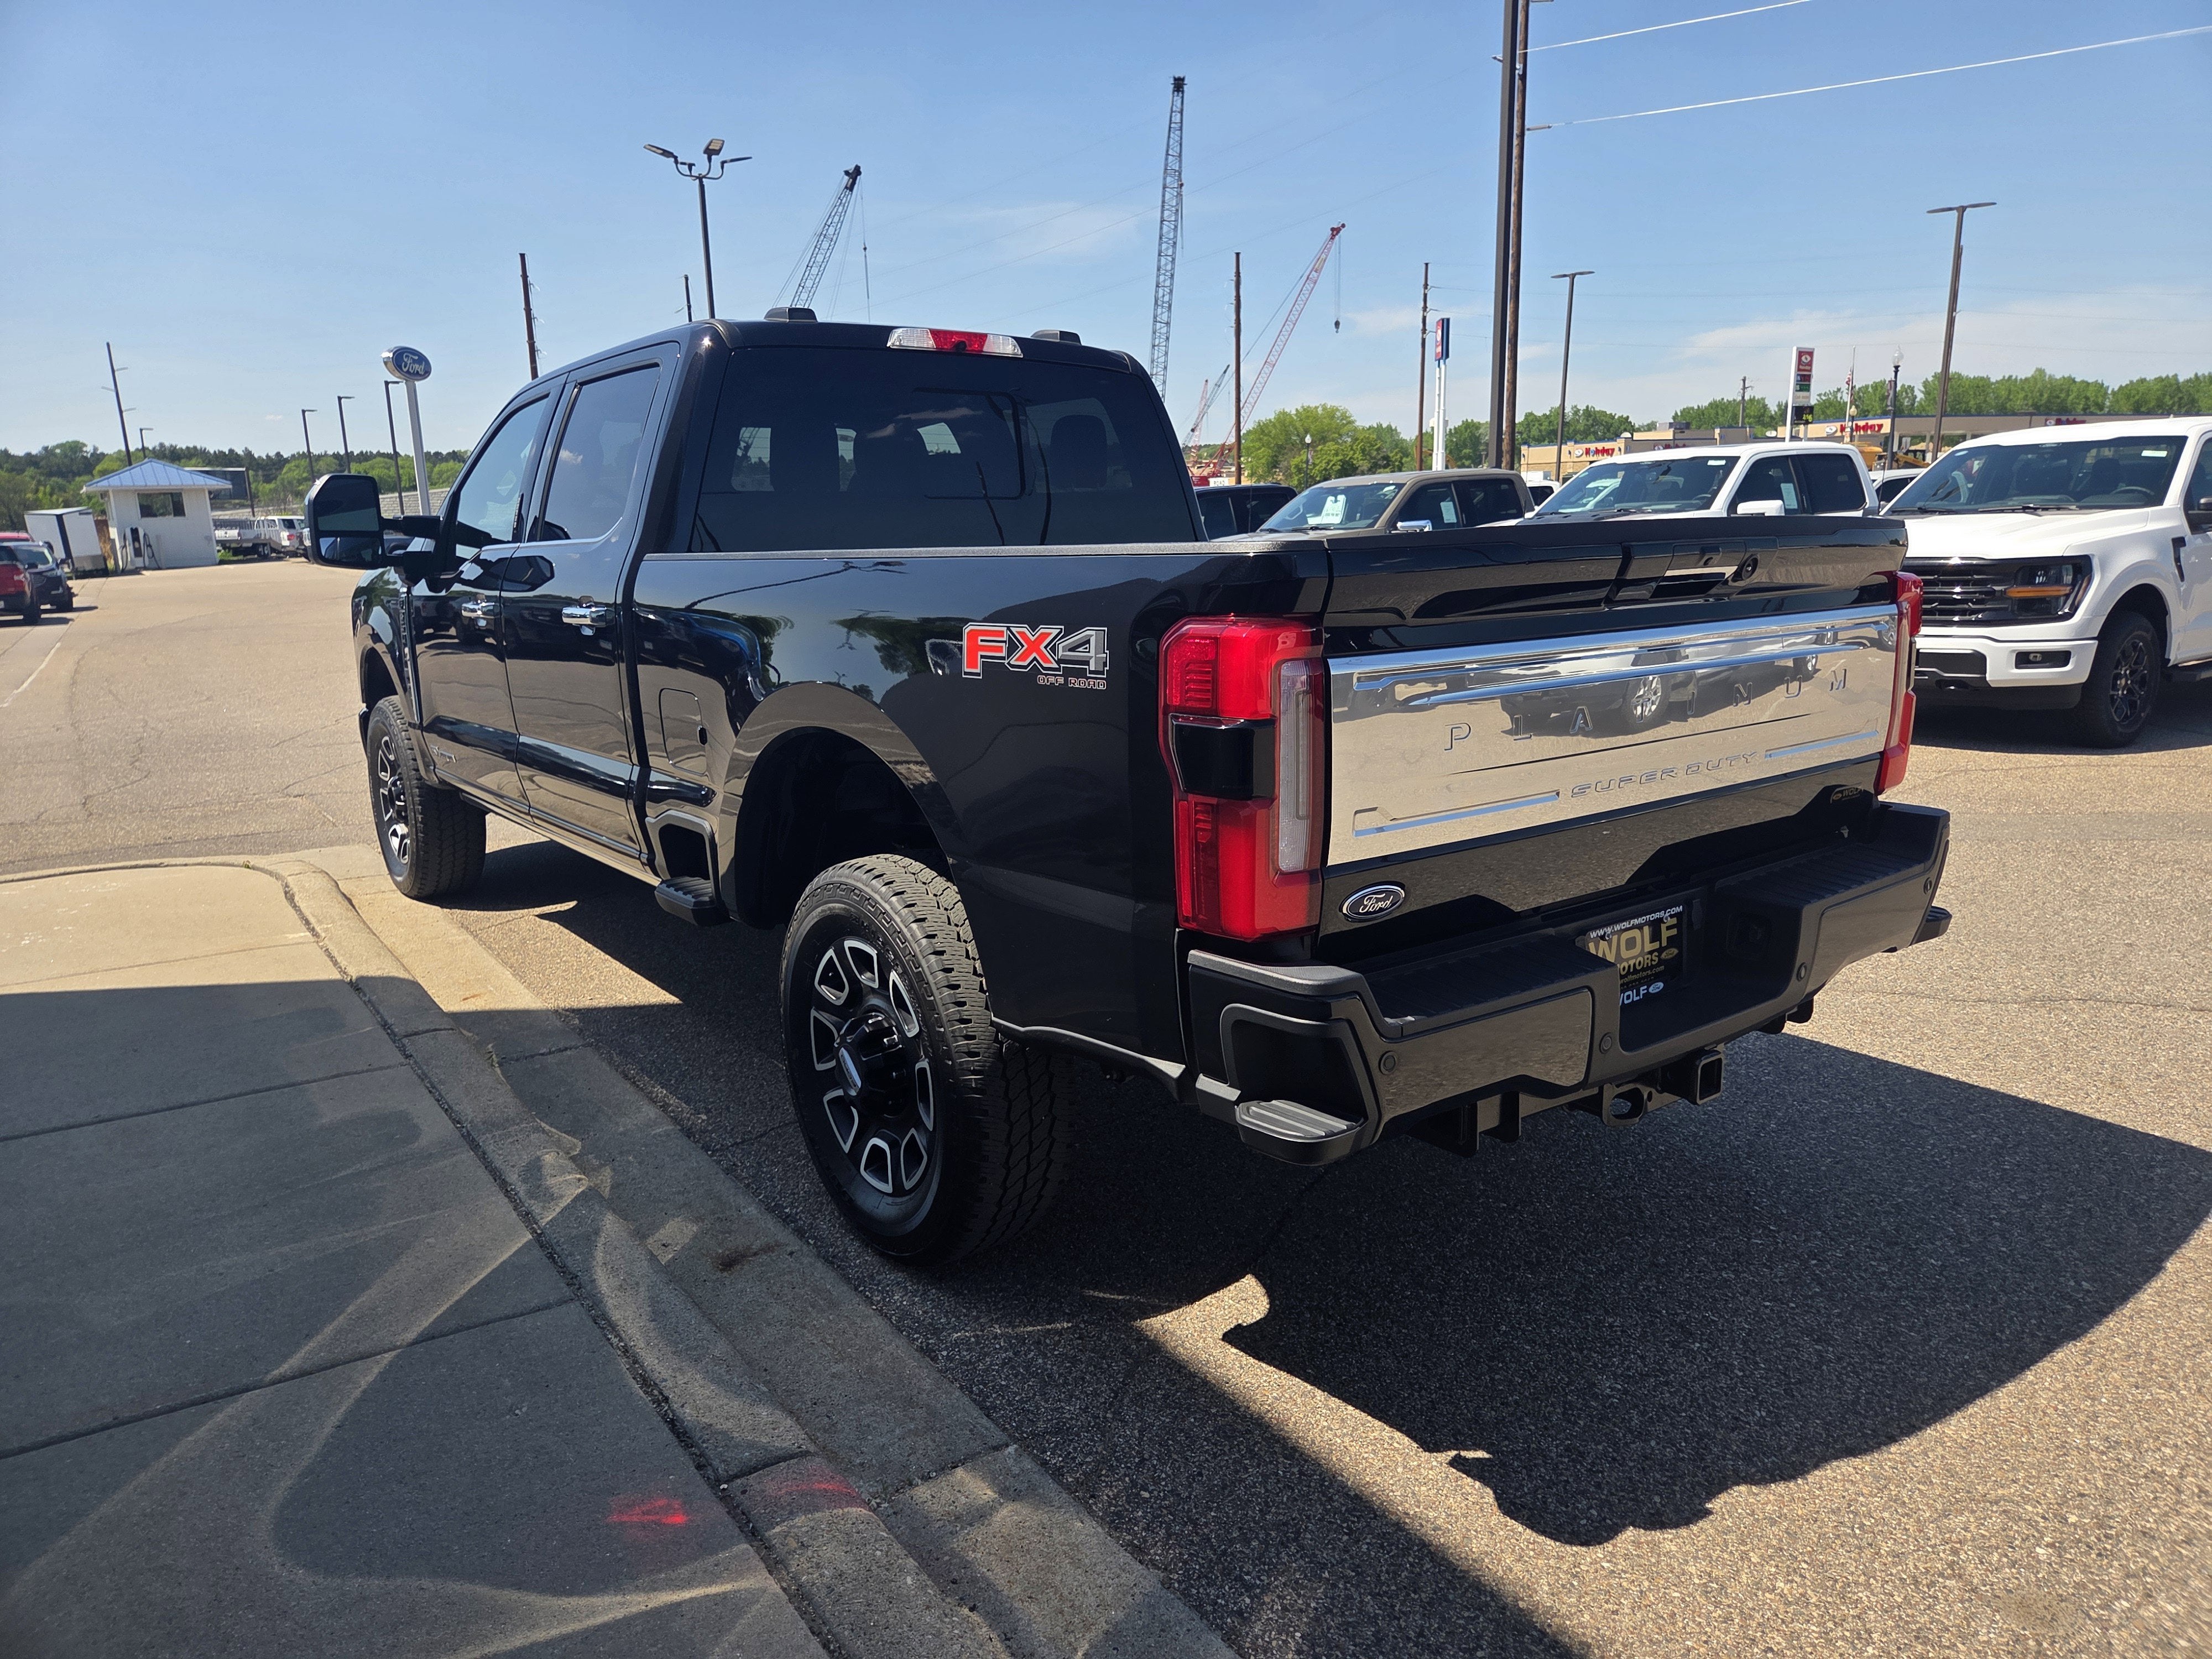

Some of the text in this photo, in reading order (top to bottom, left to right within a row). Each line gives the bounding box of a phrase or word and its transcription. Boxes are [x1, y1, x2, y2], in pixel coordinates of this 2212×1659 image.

[401, 352, 425, 375] Ford
[1840, 422, 1884, 436] Hliday
[962, 622, 1109, 679] FX4
[1037, 675, 1107, 690] OFF ROAD
[1444, 667, 1848, 751] PLATINUM
[1571, 751, 1758, 798] SUPER DUTY
[1359, 893, 1394, 913] Ford
[1588, 917, 1678, 963] WOLF
[1618, 952, 1658, 975] OTORS
